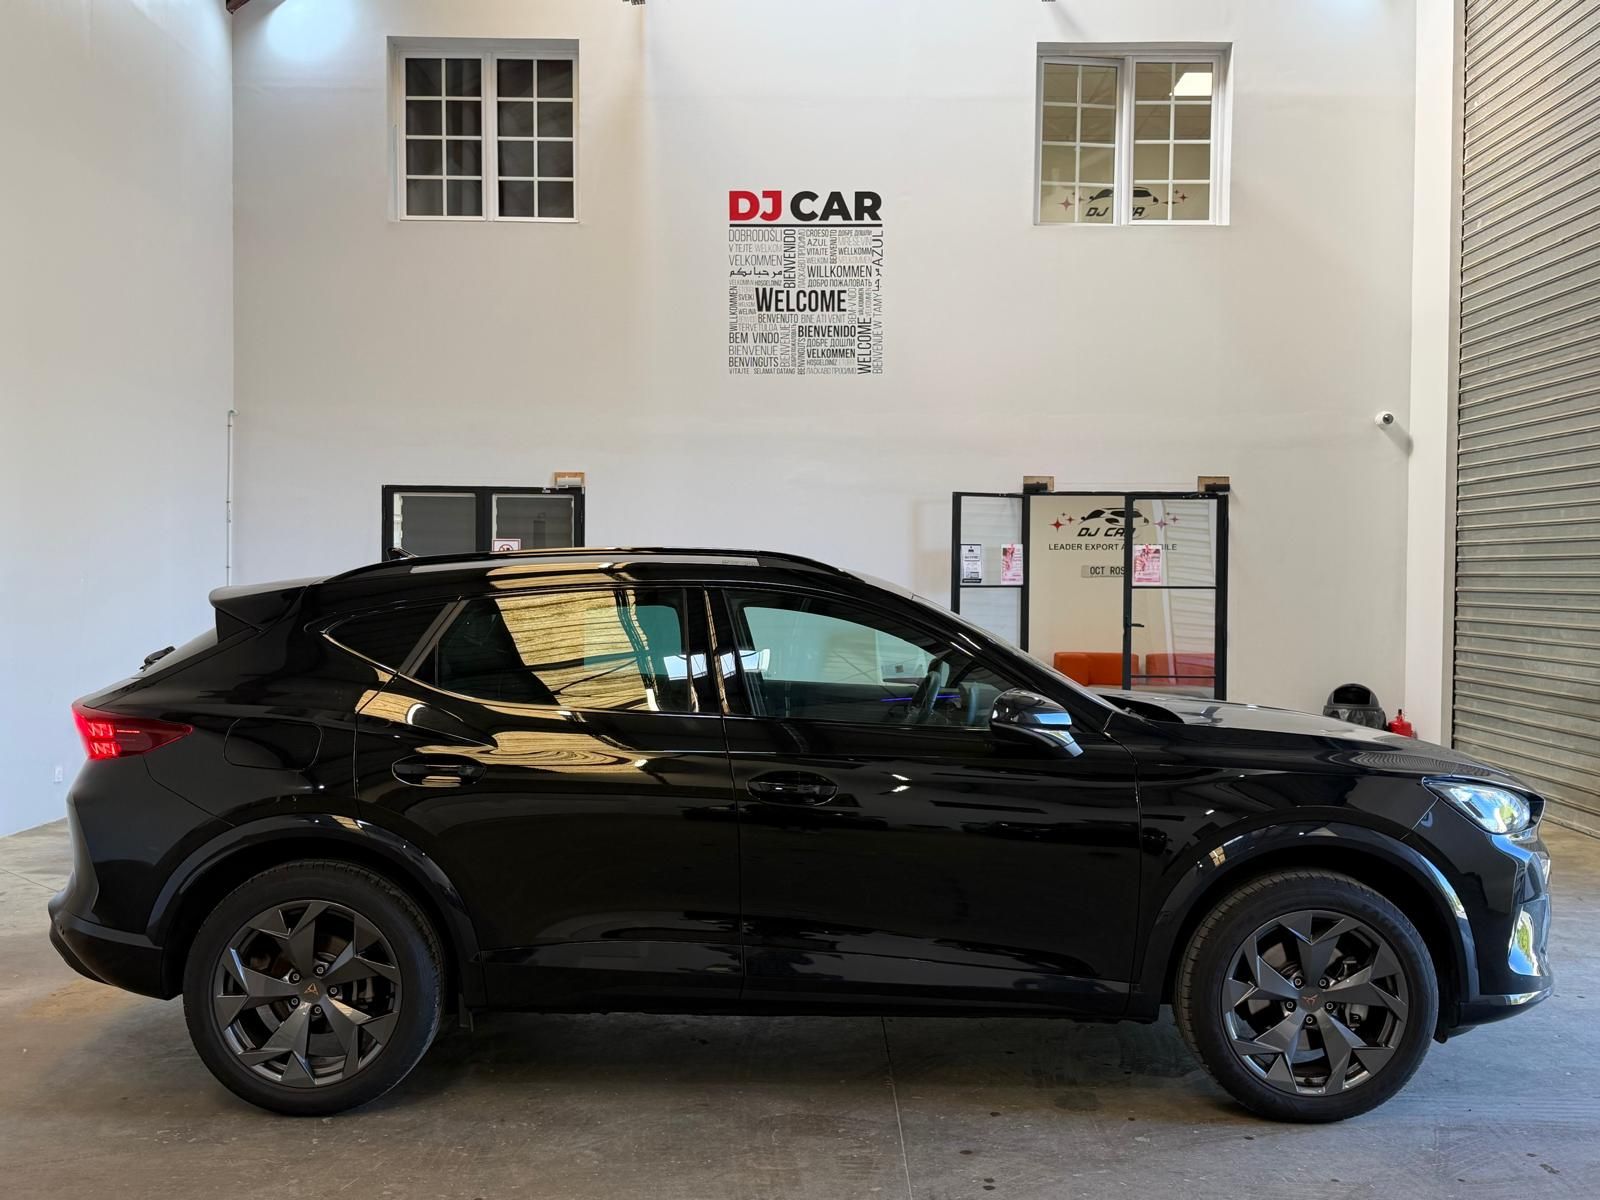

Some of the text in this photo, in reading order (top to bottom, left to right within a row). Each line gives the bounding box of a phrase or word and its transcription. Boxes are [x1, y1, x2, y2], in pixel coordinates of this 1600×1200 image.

[729, 190, 882, 221] DJ CAR
[872, 230, 884, 267] AZUL
[729, 255, 782, 266] VELKOMMEN
[784, 228, 796, 288] BIENVENIDO
[807, 266, 872, 278] WILLKOMMEN
[755, 287, 847, 312] WELCOME
[729, 286, 738, 332] WILLKOMMEN
[848, 288, 856, 324] BEM-VNDO
[758, 314, 798, 324] BENVENUTO
[729, 332, 780, 344] BEM VINDO
[798, 326, 856, 338] BIENVENIDO
[729, 345, 778, 356] BIENVENUE
[858, 317, 872, 374] WELCOME
[806, 348, 856, 358] VELKOMMEN
[729, 356, 778, 368] BENVINGUTS
[1077, 528, 1136, 536] DJ CA
[1090, 566, 1125, 575] OCT ROS
